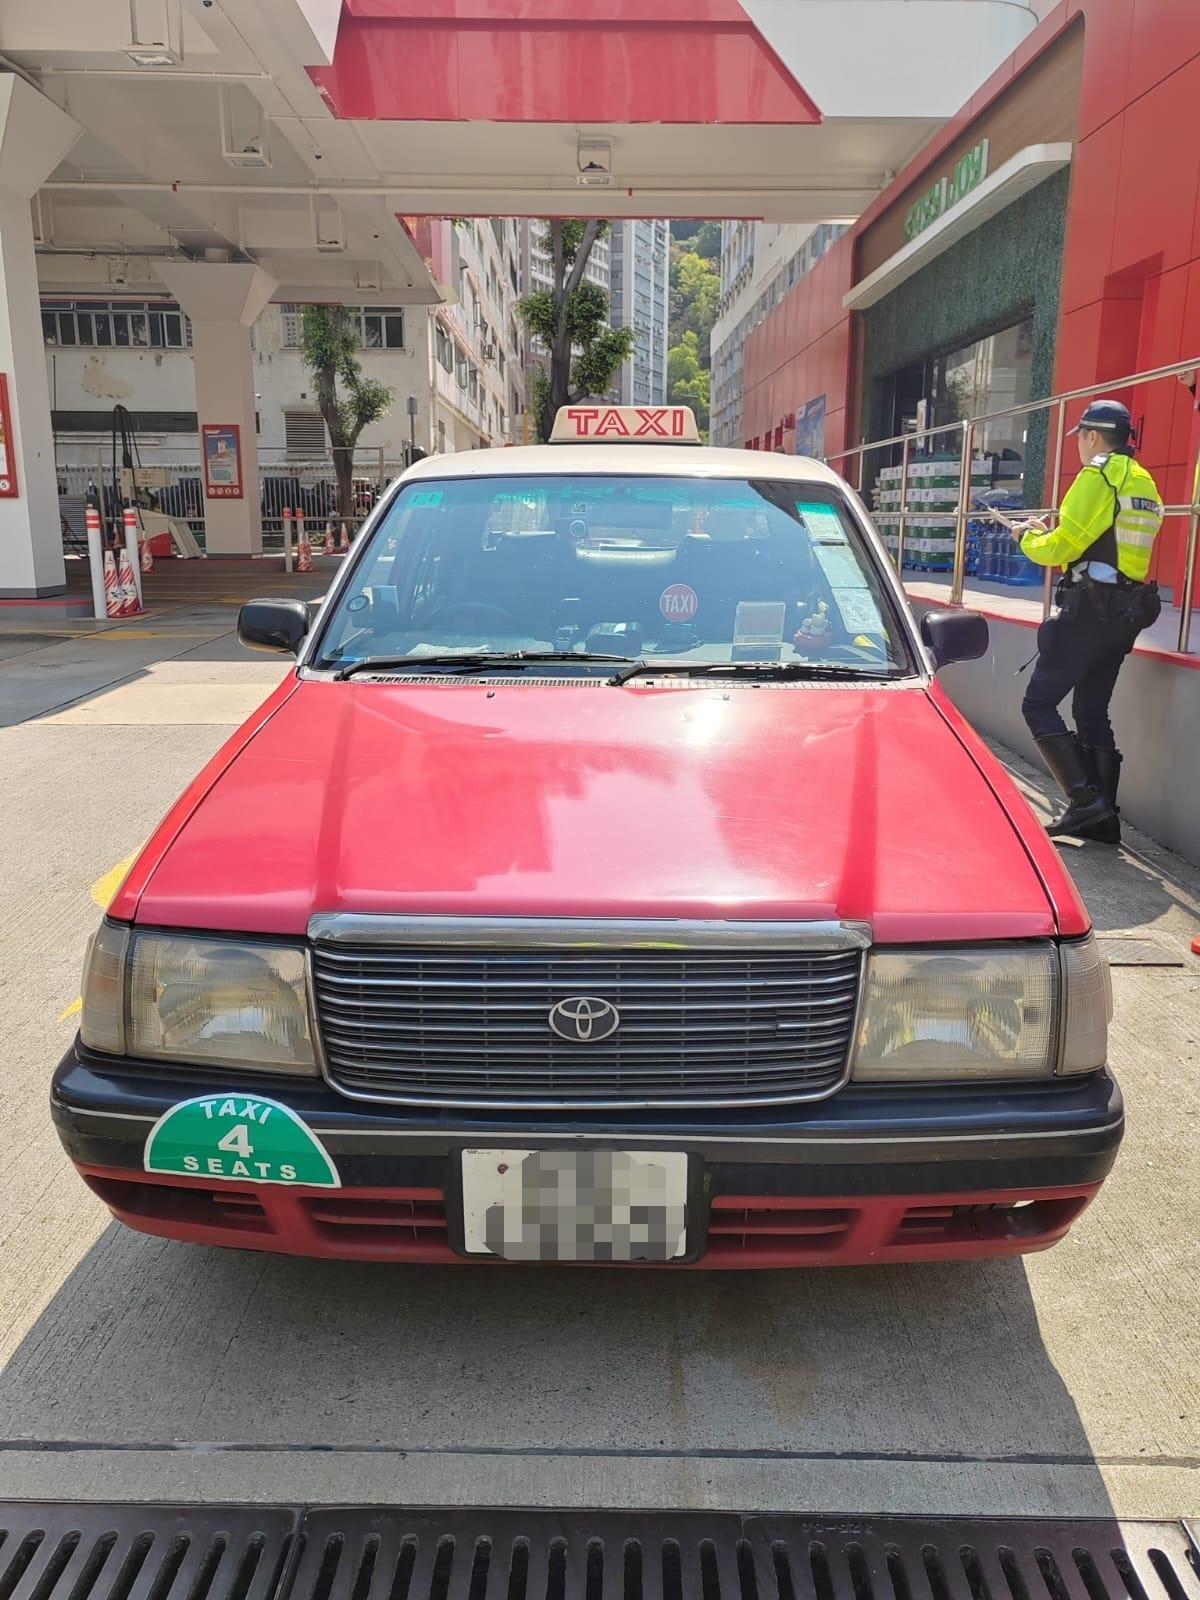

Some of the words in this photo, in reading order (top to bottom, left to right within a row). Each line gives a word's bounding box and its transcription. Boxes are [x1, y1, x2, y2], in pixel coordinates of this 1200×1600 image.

[567, 409, 684, 436] TAXI
[663, 594, 694, 613] TAXI
[200, 1099, 272, 1125] TAXI
[218, 1124, 254, 1158] 4
[183, 1156, 297, 1180] SEATS
